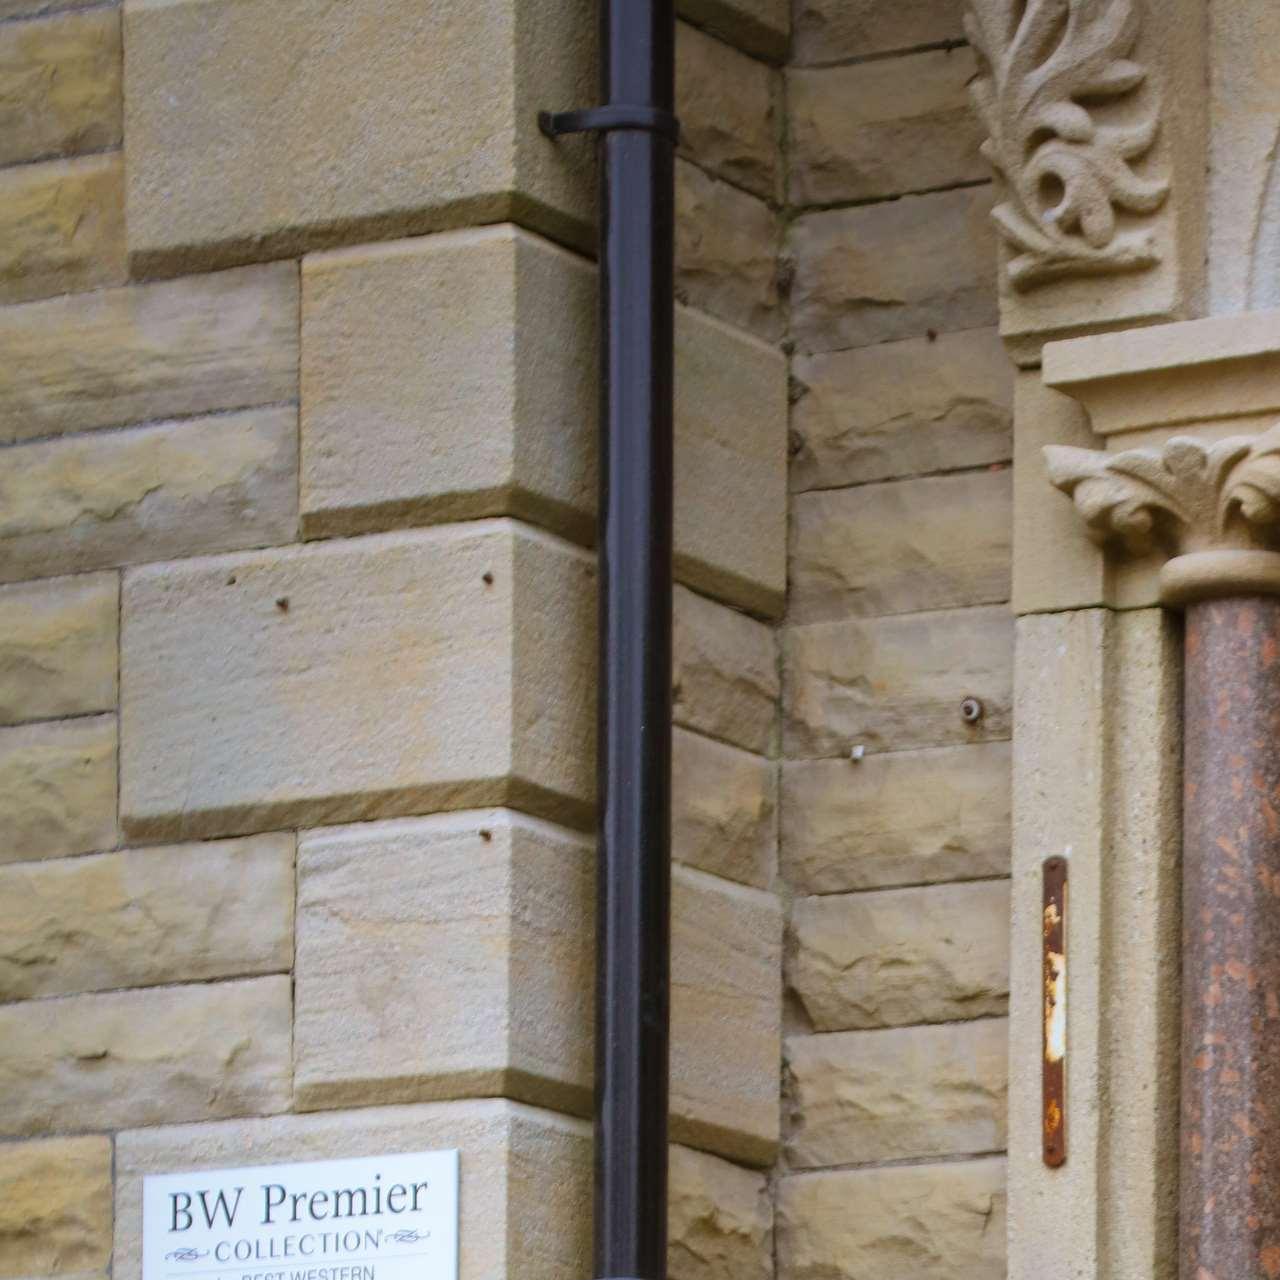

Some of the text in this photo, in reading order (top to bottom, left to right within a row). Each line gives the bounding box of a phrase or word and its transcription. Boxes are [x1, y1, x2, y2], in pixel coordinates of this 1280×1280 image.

[168, 1173, 428, 1233] BW Premier
[214, 1229, 380, 1263] COLLECTION
